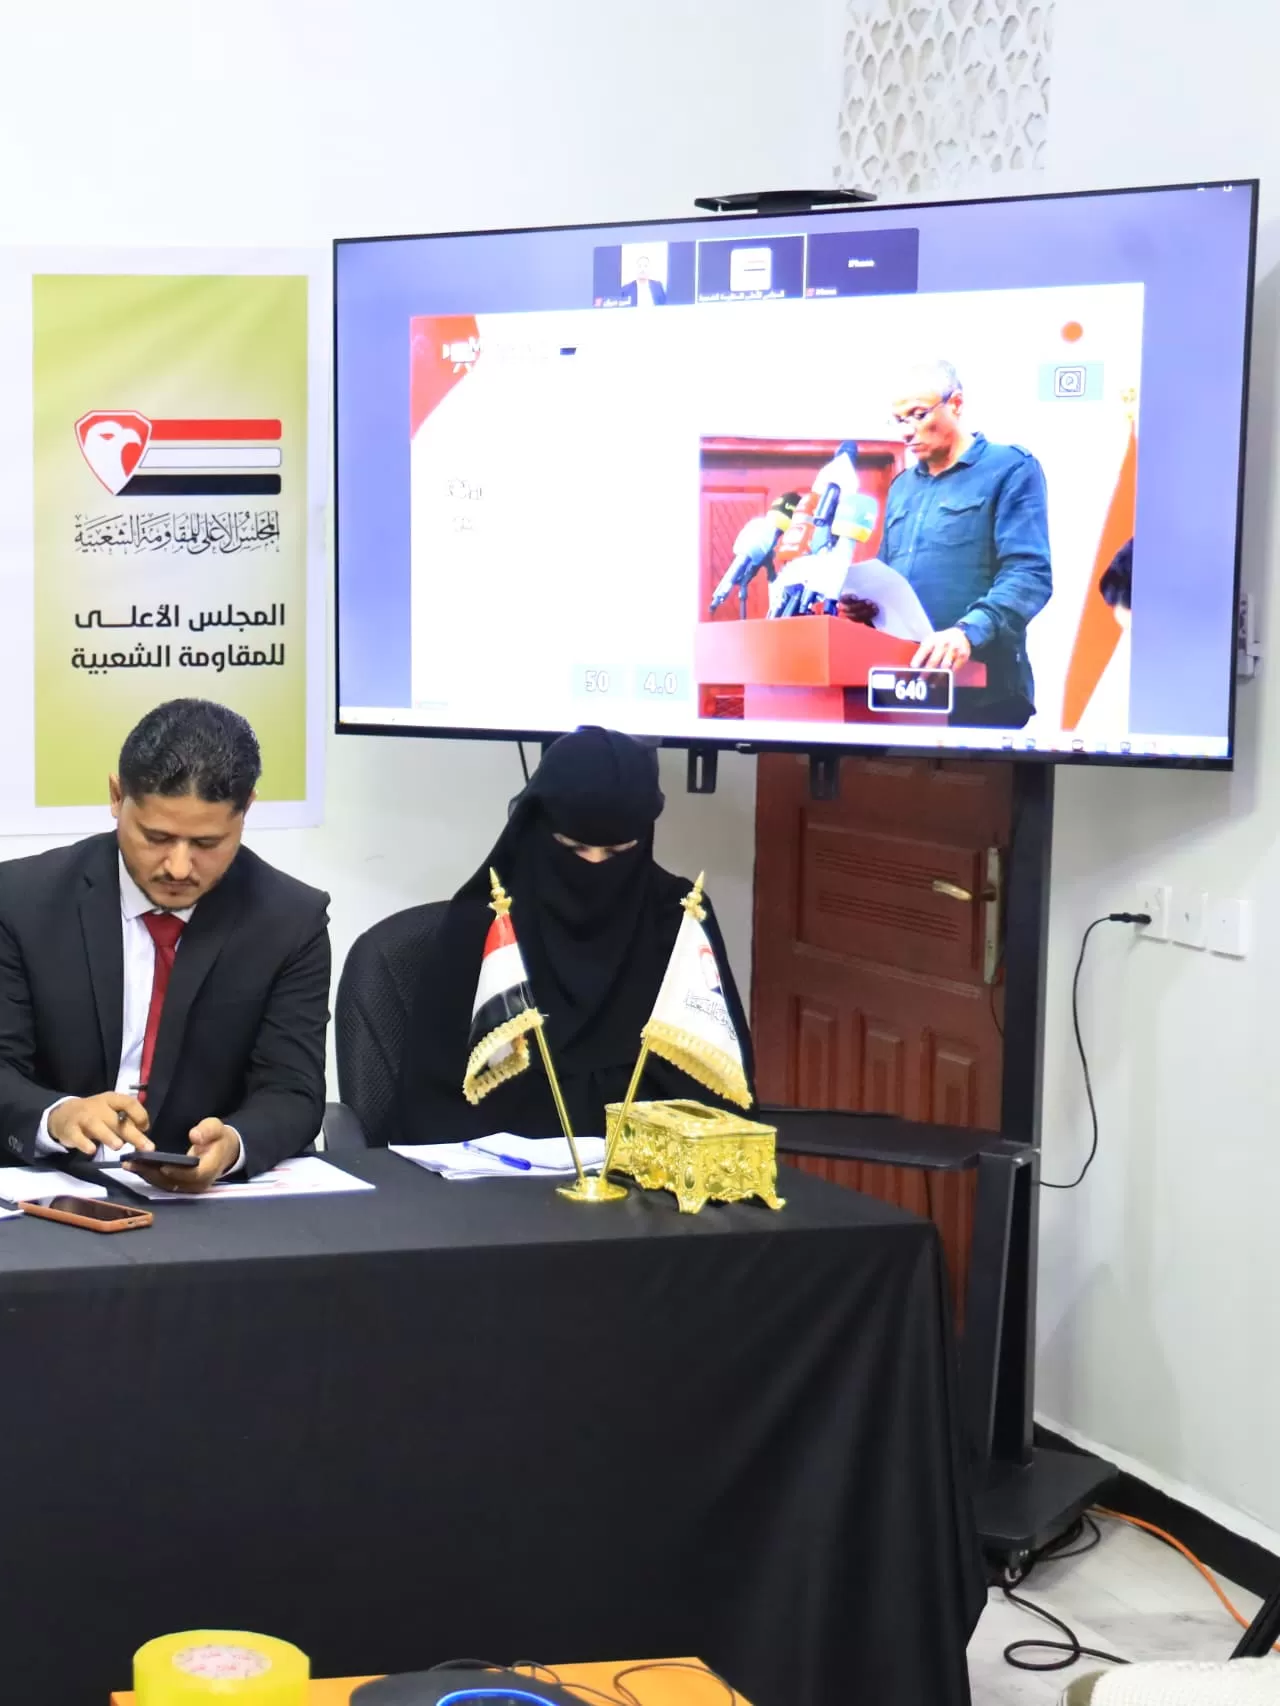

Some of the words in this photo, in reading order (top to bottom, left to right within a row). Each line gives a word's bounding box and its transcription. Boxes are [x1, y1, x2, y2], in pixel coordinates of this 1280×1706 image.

[75, 604, 180, 629] الأعلى
[188, 603, 285, 633] المجلس
[71, 642, 171, 675] الشعبية
[178, 643, 285, 673] للمقاومة
[585, 670, 610, 693] 50
[643, 672, 678, 694] 4.0
[894, 679, 927, 701] 640
